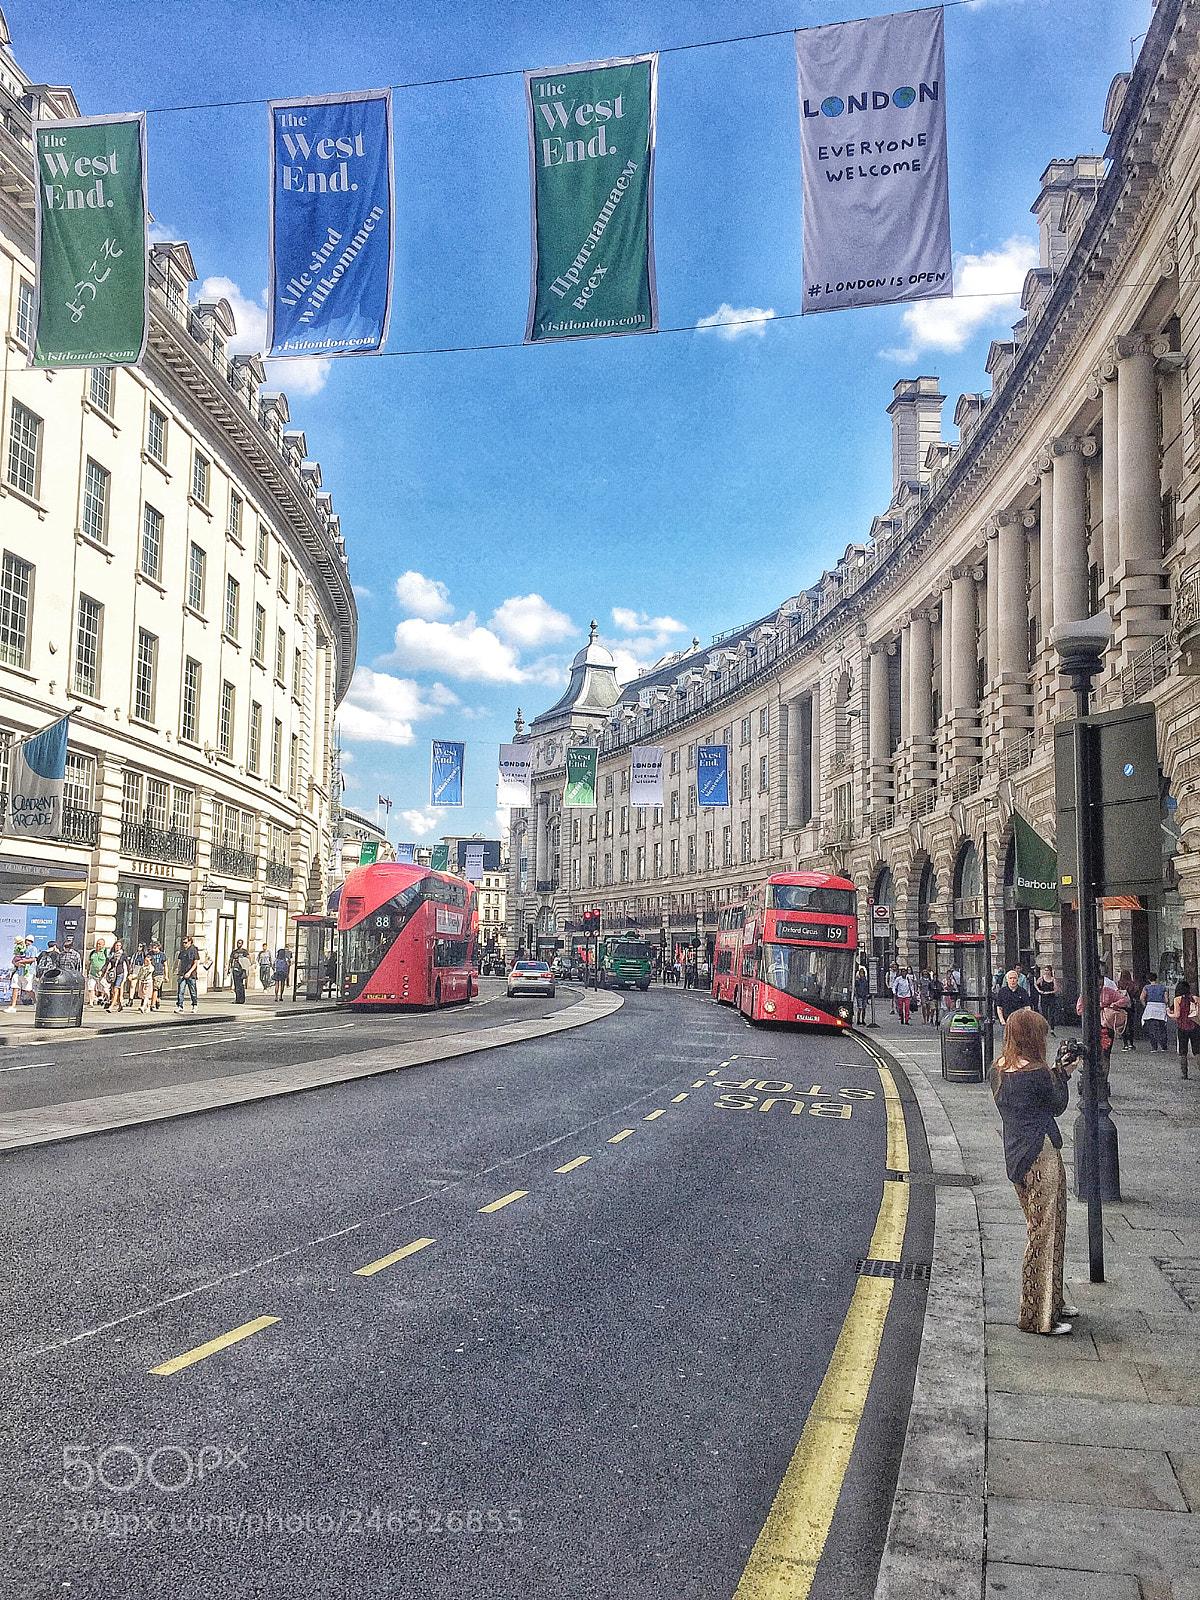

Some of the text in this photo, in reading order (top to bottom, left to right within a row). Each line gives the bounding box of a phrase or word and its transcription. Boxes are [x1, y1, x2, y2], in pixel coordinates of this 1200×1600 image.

[536, 82, 566, 97] The
[804, 81, 939, 118] LONDON
[279, 113, 307, 127] The
[537, 91, 627, 131] West
[41, 135, 67, 148] The
[282, 130, 366, 160] West
[542, 125, 617, 167] End.
[818, 133, 927, 160] EVERYONE
[43, 148, 119, 179] West
[826, 159, 921, 182] WELCOME
[282, 162, 358, 192] End.
[44, 179, 114, 210] End.
[548, 159, 639, 300] Приглашаем
[280, 227, 343, 306] Alle sind
[571, 263, 609, 311] всех
[890, 276, 903, 287] IS
[908, 272, 946, 284] OPEN
[9, 794, 59, 816] QUADRANT
[13, 813, 52, 829] ARCADE
[131, 860, 175, 877] STEFANEL
[1017, 877, 1057, 889] Barbour
[376, 916, 390, 927] 88
[782, 926, 801, 935] Oxford
[827, 927, 842, 938] 159
[712, 1078, 877, 1100] STOP
[713, 1094, 853, 1120] BUS
